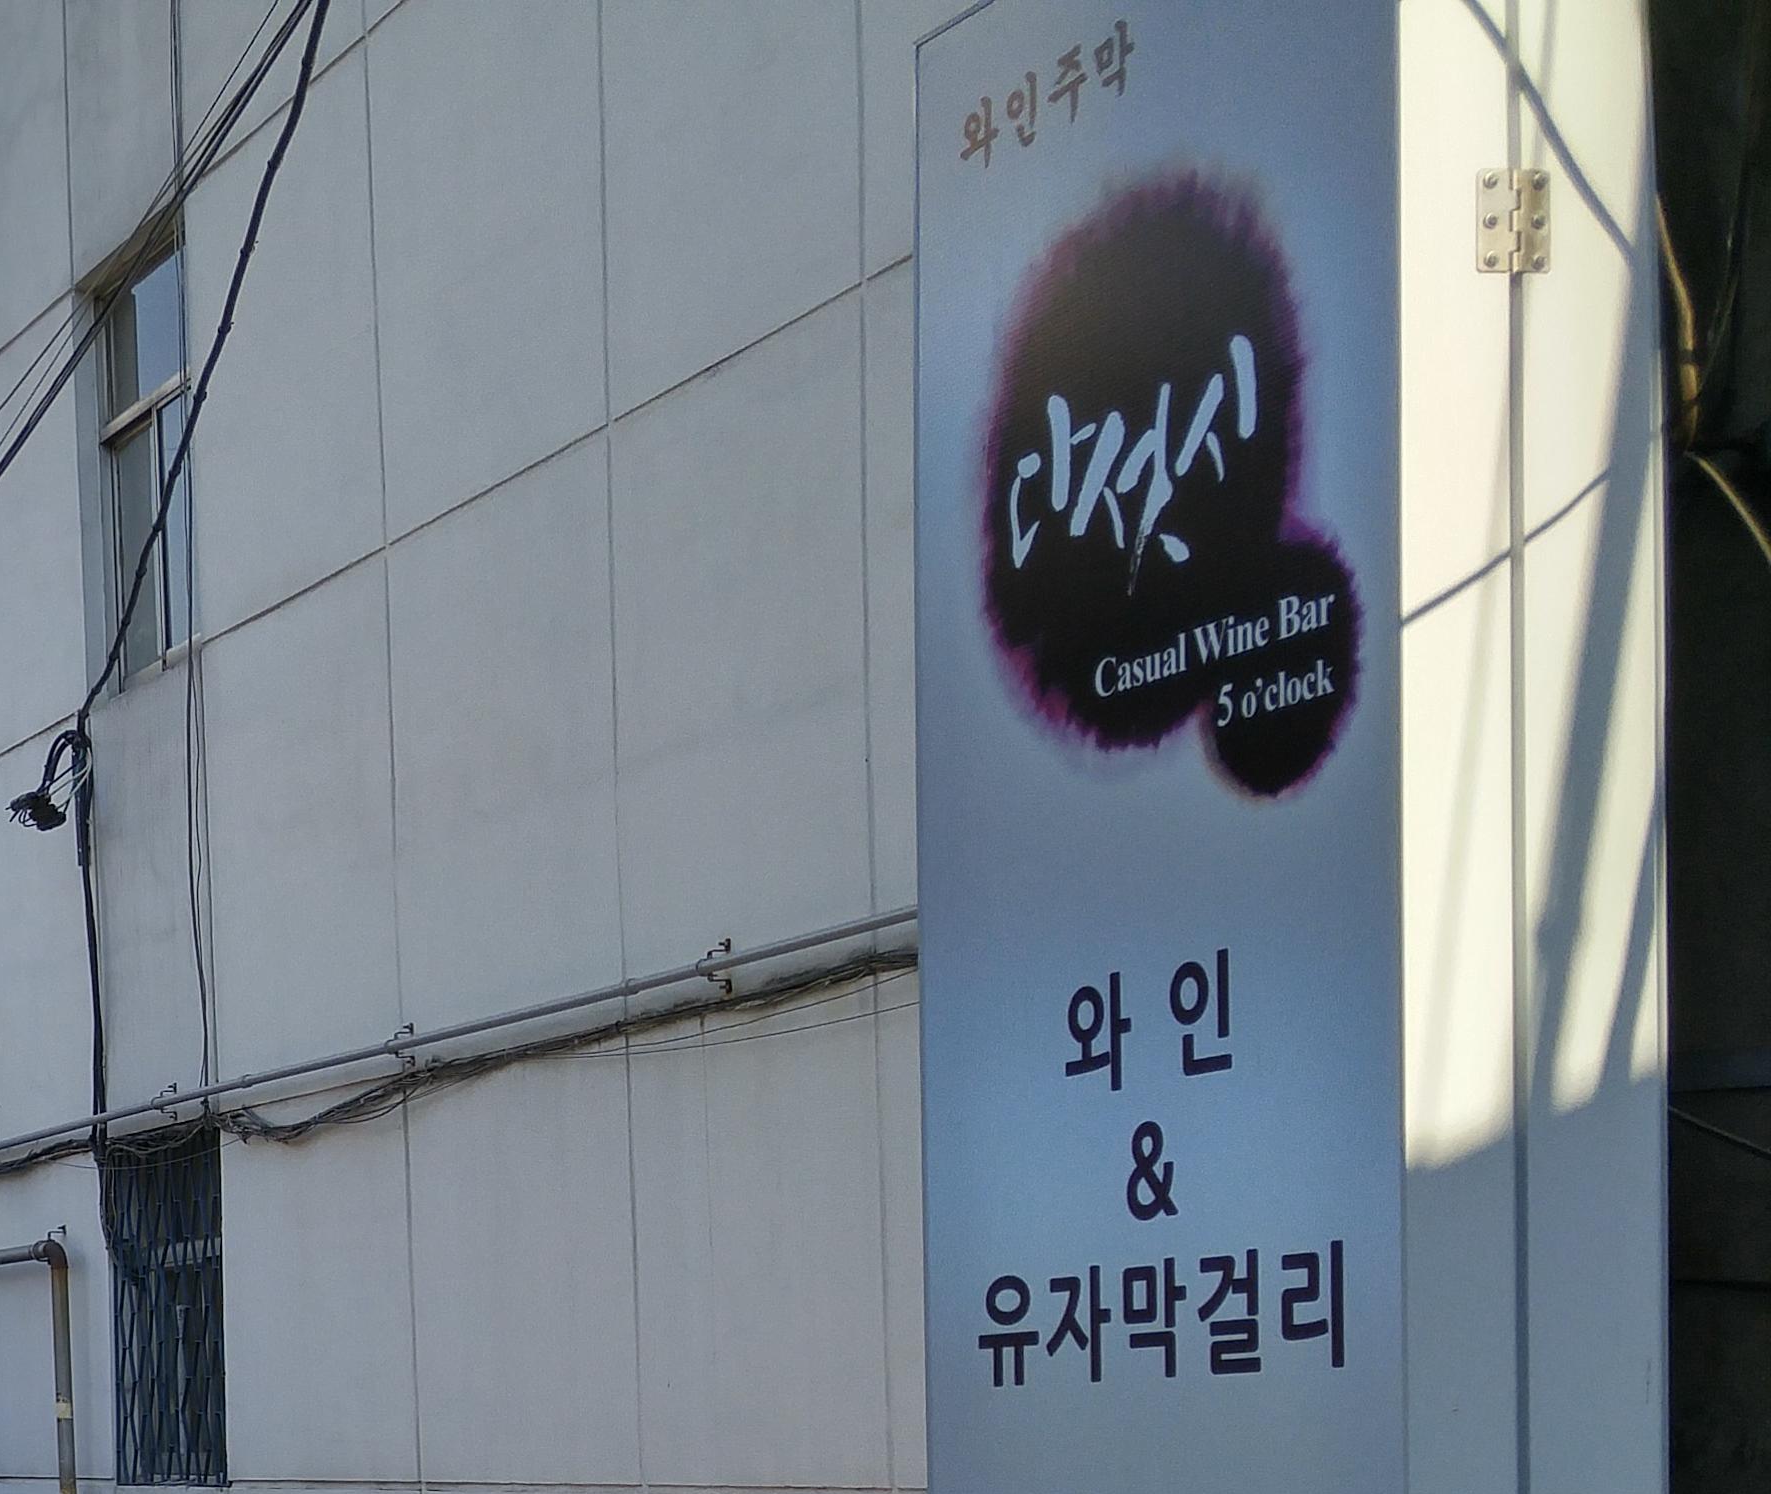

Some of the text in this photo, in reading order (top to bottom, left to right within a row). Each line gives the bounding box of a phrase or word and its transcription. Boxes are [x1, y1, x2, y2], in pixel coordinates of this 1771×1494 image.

[959, 20, 1136, 168] 와인주막
[1094, 595, 1336, 698] Casual Wine Bar
[1217, 659, 1335, 727] 5 o'clock
[1126, 1120, 1179, 1221] &
[976, 1239, 1347, 1387] 유자막걸리
